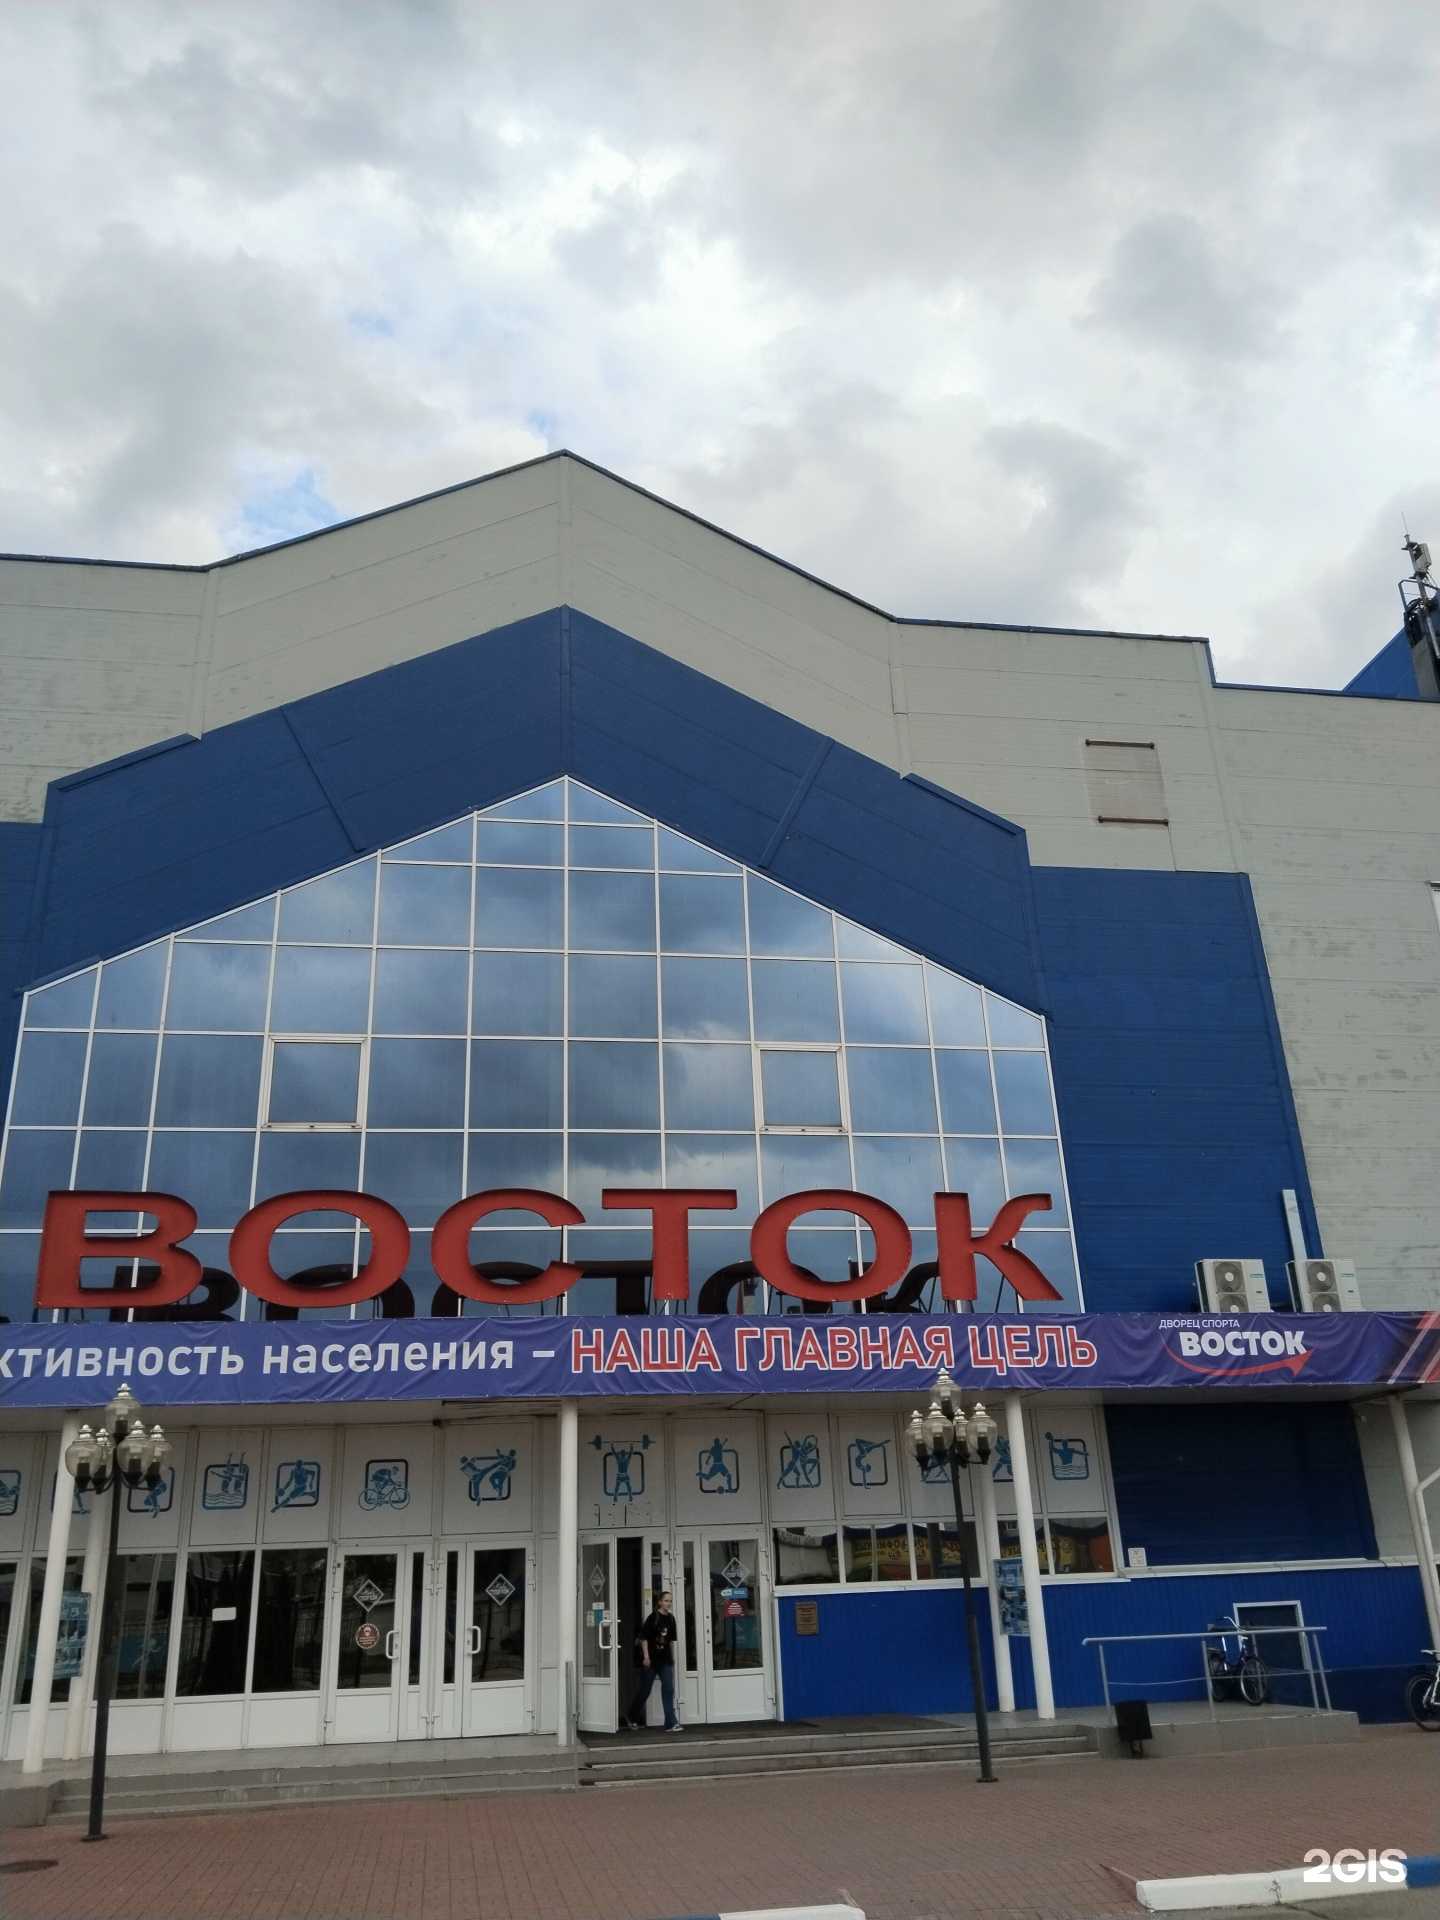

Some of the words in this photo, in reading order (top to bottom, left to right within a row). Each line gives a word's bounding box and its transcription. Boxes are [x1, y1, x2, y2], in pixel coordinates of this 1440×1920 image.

[34, 1188, 1064, 1309] ВОСТОК
[1159, 1319, 1200, 1329] ДВОРЕЦ
[1201, 1318, 1241, 1329] СПОРТА
[262, 1340, 515, 1375] населения
[570, 1328, 723, 1373] НАША
[735, 1325, 953, 1371] ГЛАВНАЯ
[969, 1324, 1098, 1376] ЦЕЛЬ
[1178, 1331, 1307, 1356] ВОСТОК
